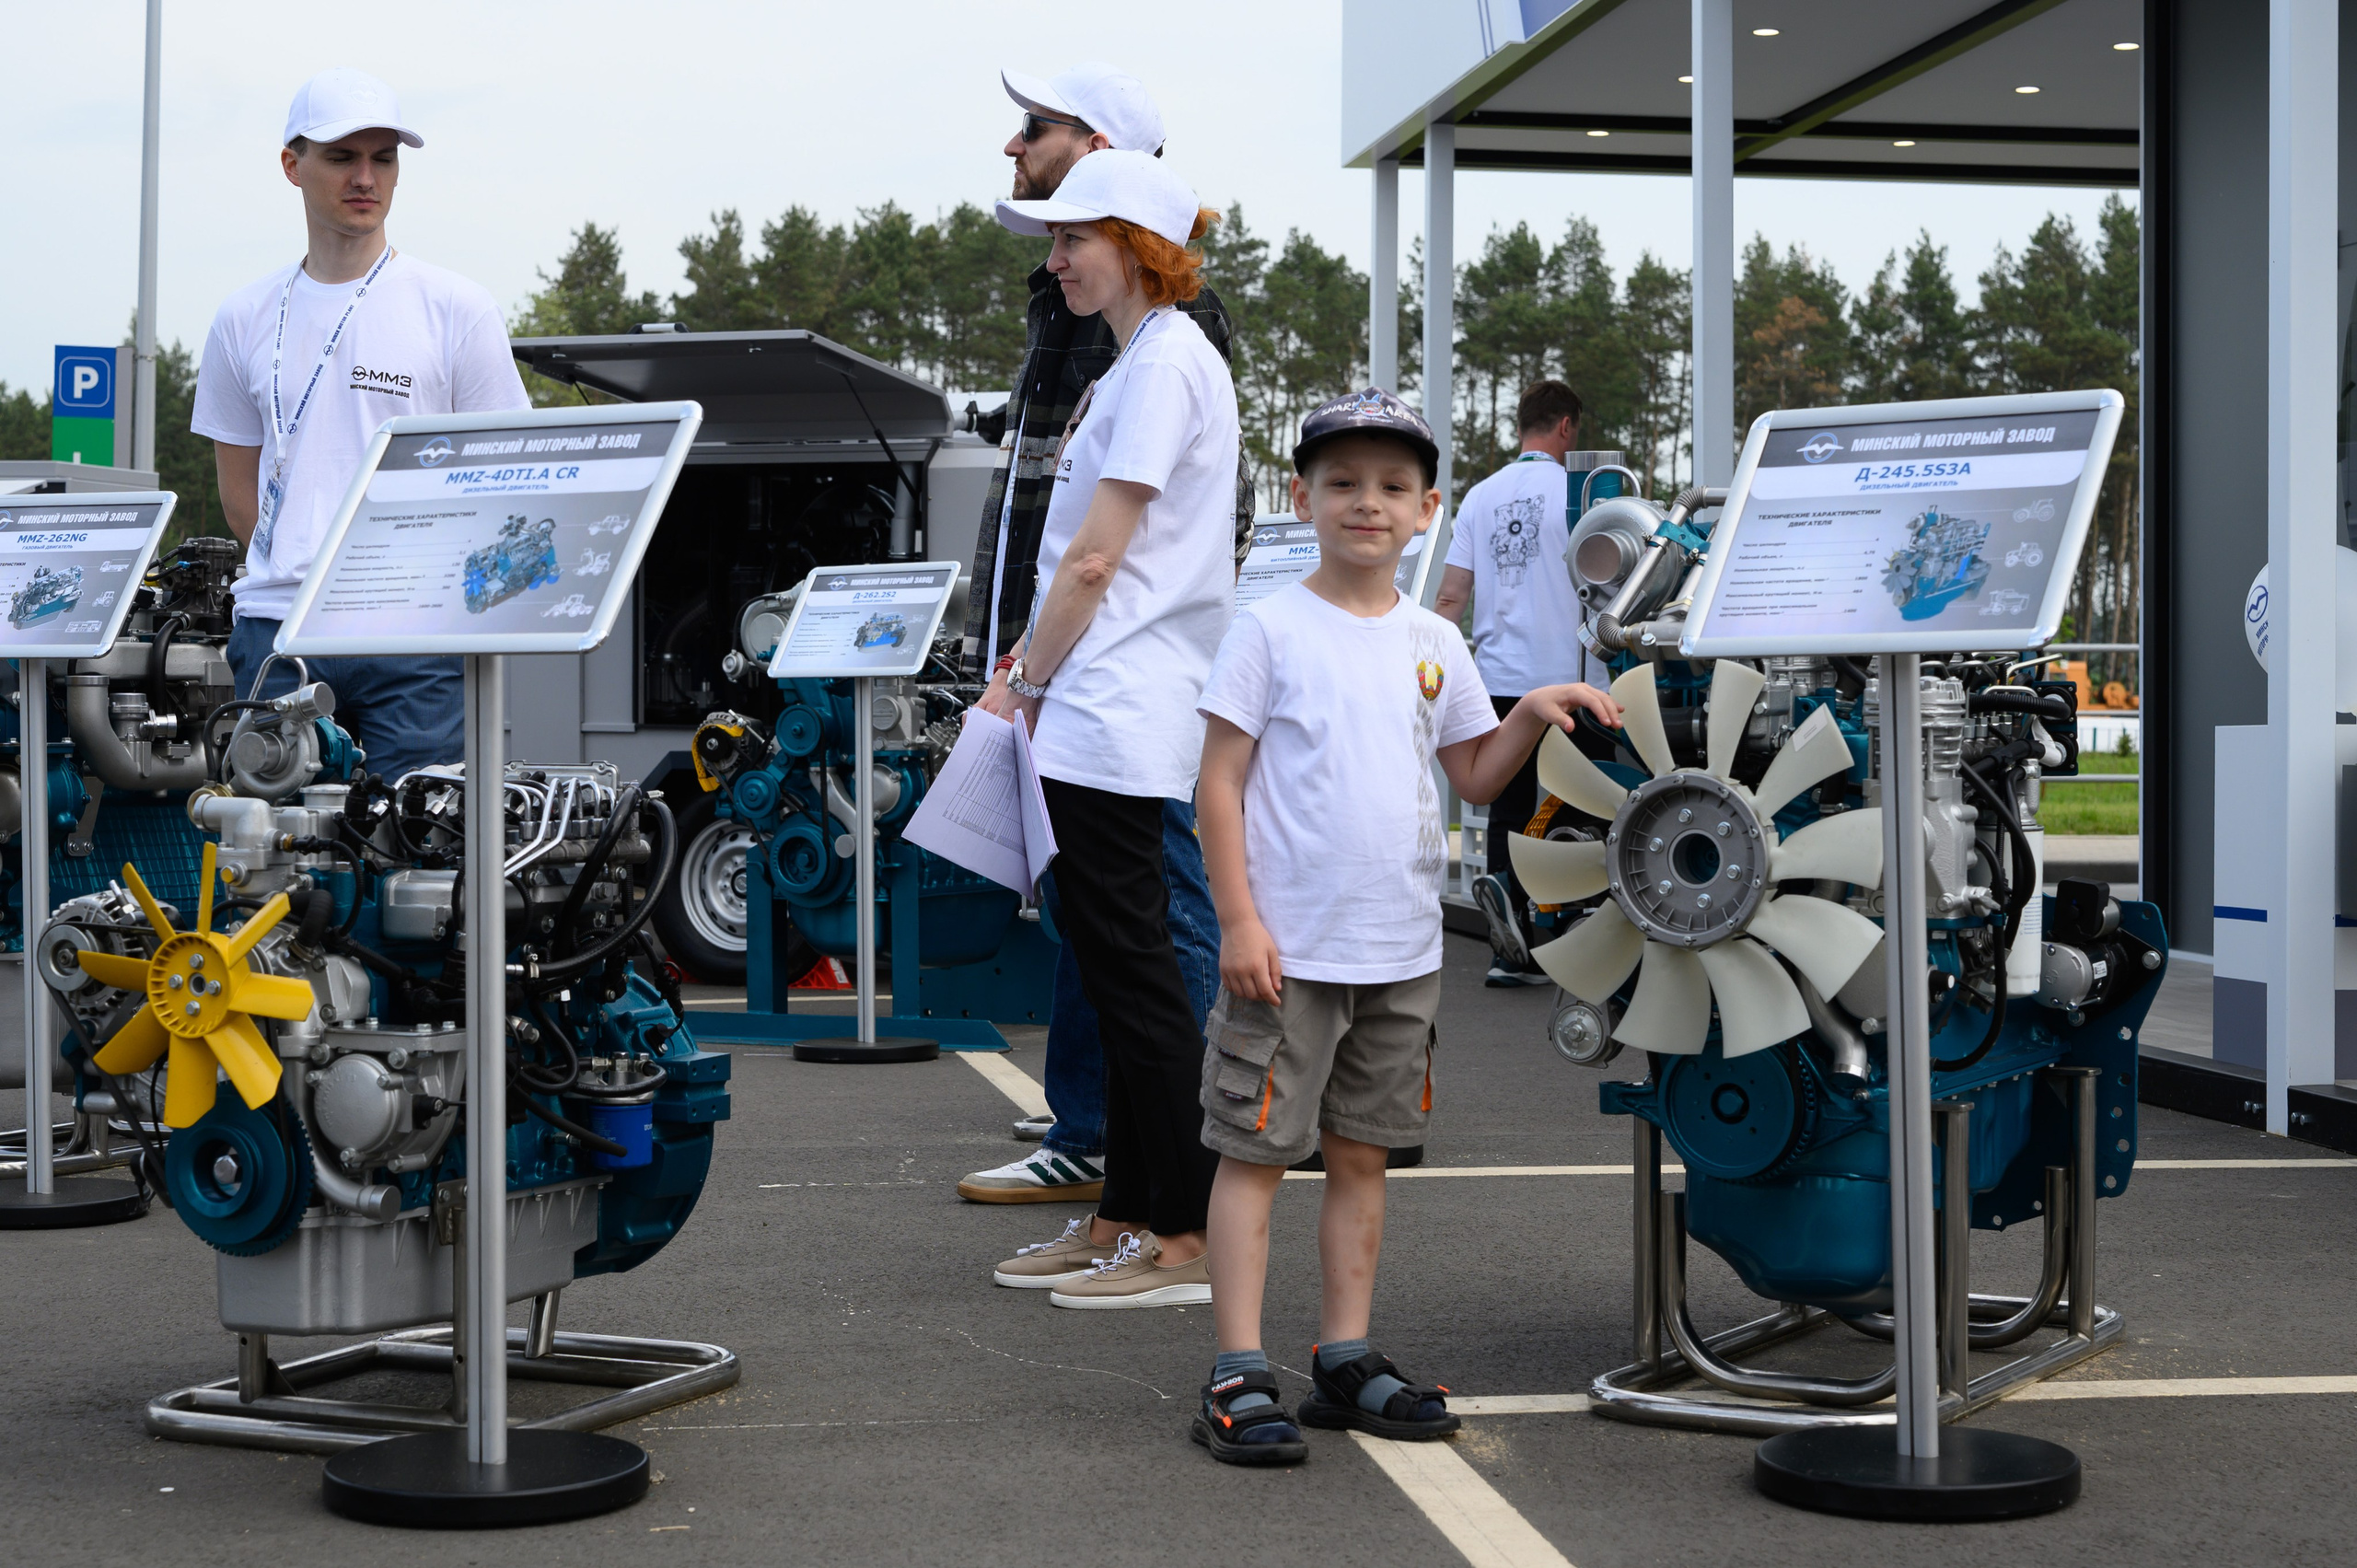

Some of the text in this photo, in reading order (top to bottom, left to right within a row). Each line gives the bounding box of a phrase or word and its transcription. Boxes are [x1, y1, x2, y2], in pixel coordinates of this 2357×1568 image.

[74, 366, 99, 399] P
[461, 433, 642, 457] МИНСКИЙ МОТОРНЫЙ ЗАВОД
[1851, 427, 2056, 452] МИНСКИЙ МОТОРНЫЙ ЗАВОД
[445, 467, 580, 484] MMZ-4DTI.A CR
[462, 483, 549, 494] ДИЗЕЛЬНЫЙ ДВИГАТЕЛЬ
[1860, 481, 1958, 492] ДИЗЕЛЬНЫЙ ДВИГАТЕЛЬ
[17, 511, 138, 525] МИНСКИЙ МОТОРНЫЙ ЗАВОД
[416, 511, 477, 520] ХАРАКТЕРИСТИКИ
[1758, 509, 1881, 520] ТЕХНИЧЕСКИЕ ХАРАКТЕРИСТИКИ
[393, 522, 434, 530] ДВИГАТЕЛЯ
[17, 533, 87, 543] MMZ-262NG
[1285, 529, 1317, 539] МИНСК
[850, 577, 880, 586] МИНСКИЙ
[880, 575, 913, 585] МОТОРНЫЙ
